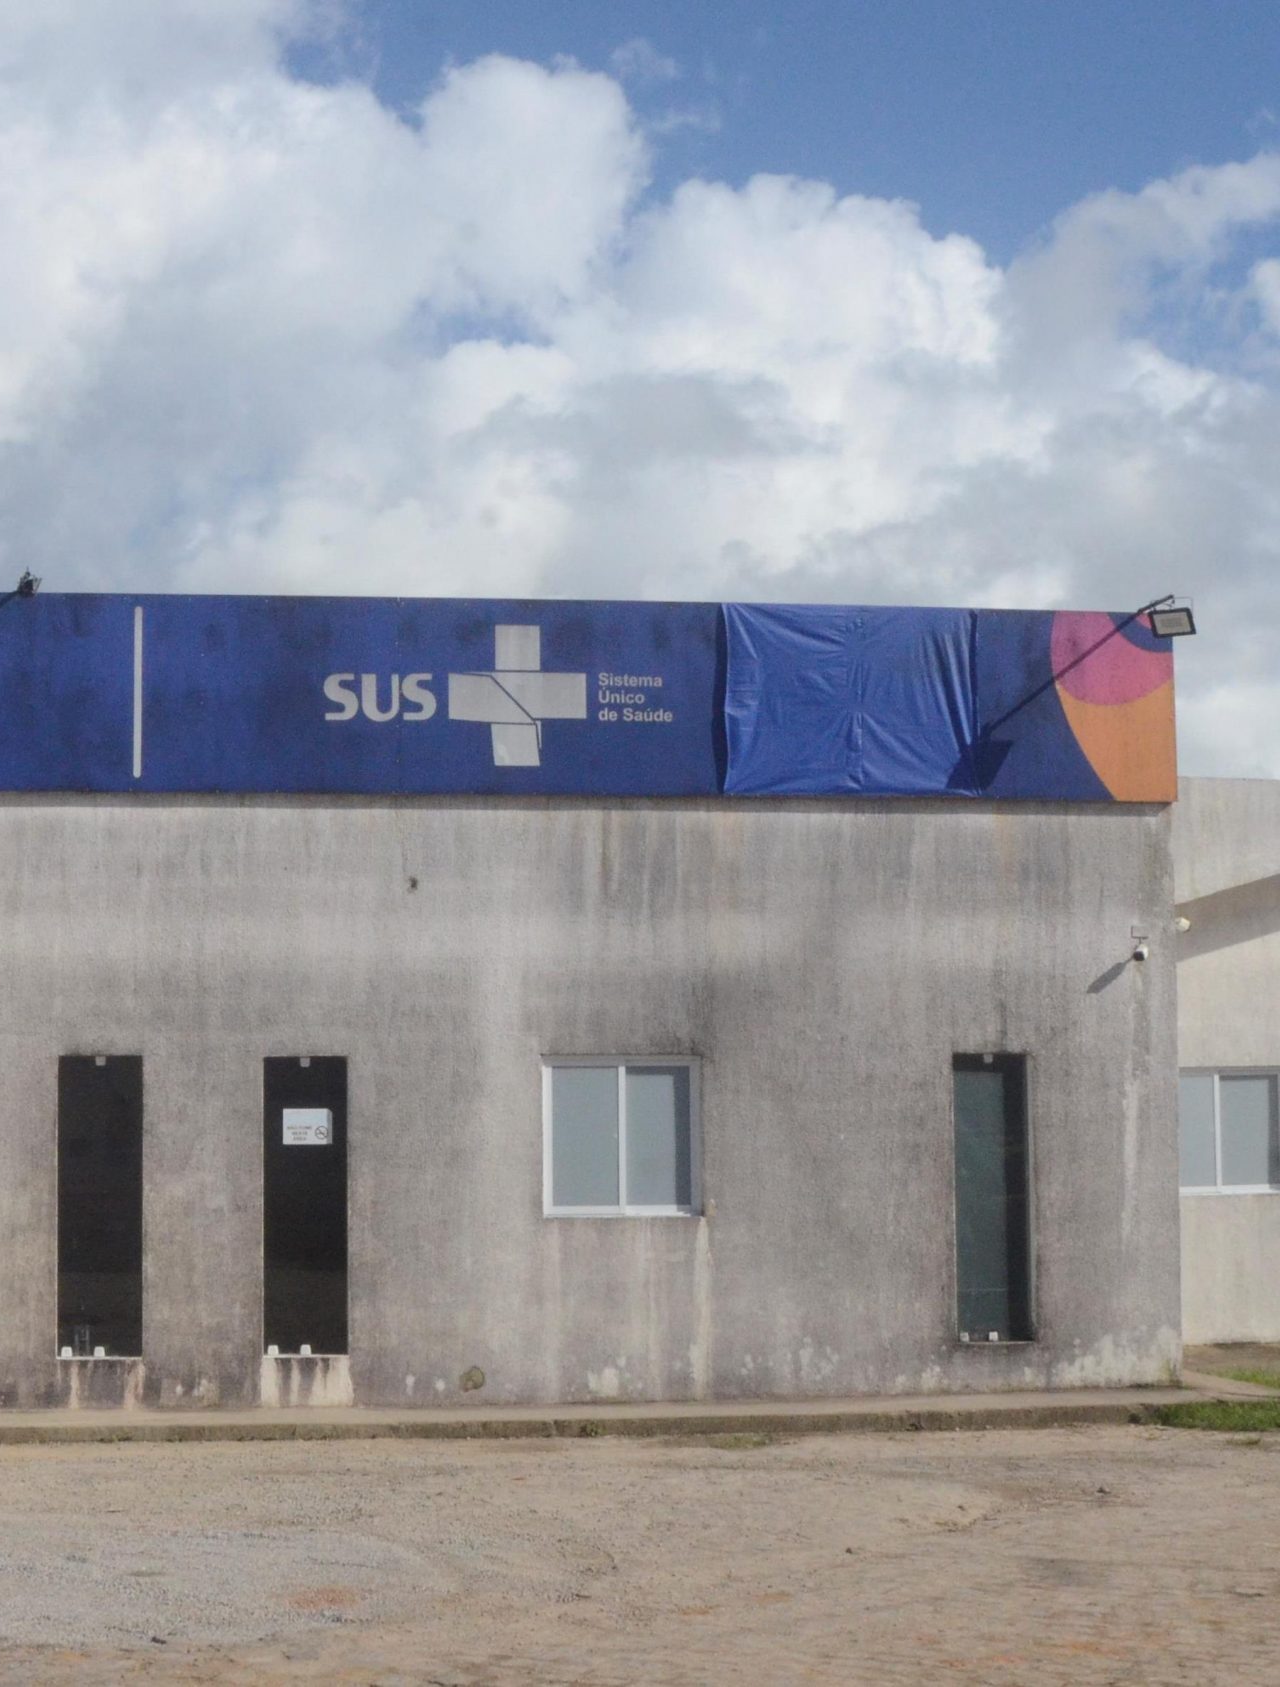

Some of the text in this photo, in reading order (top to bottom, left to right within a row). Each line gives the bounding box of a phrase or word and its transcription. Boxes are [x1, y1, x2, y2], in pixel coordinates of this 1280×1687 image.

[598, 672, 663, 687] Sistema
[323, 672, 437, 722] SUS
[598, 687, 645, 704] Único
[598, 707, 673, 722] de Saúde
